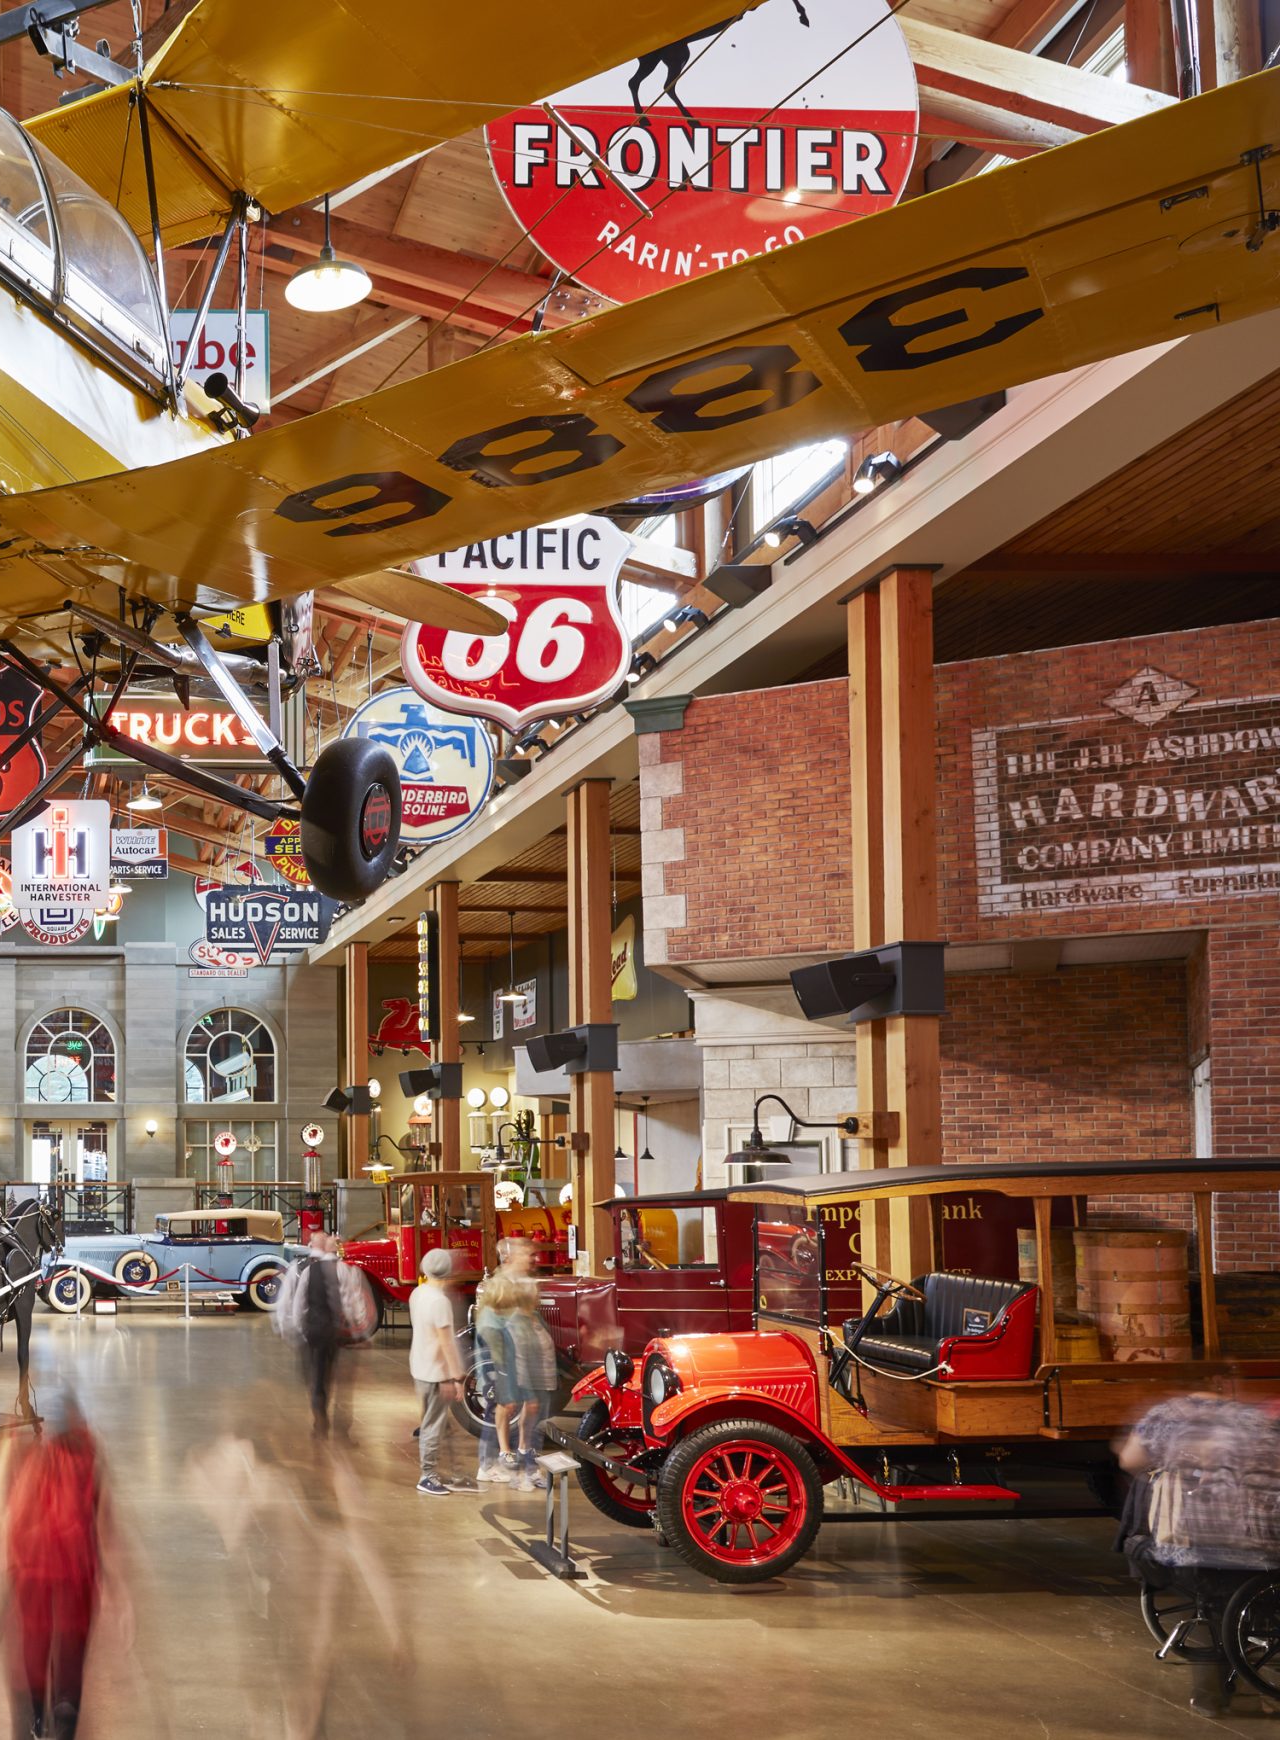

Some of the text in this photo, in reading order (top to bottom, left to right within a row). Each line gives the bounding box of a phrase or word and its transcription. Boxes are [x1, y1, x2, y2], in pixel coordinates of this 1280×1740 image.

[513, 123, 891, 194] FRONTIER
[441, 596, 594, 684] 66
[1135, 680, 1161, 708] A
[109, 711, 267, 747] TRUCKS
[403, 804, 448, 816] SOLINE
[1008, 767, 1280, 832] HARDWAR
[114, 846, 157, 855] Autocar
[1017, 832, 1173, 871] COMPANY
[134, 865, 163, 874] SERVICE
[276, 856, 311, 882] PLYM
[20, 883, 102, 893] INTERNATIONAL
[1020, 883, 1144, 909] Hardware
[1176, 871, 1280, 896] Furnitu
[29, 893, 91, 902] HARVESTER
[210, 902, 319, 922] HUDSON
[24, 917, 90, 945] PRODUCTS
[211, 927, 319, 939] SALES SERVICE
[450, 1240, 469, 1249] SHELL
[825, 1269, 862, 1281] EXP
